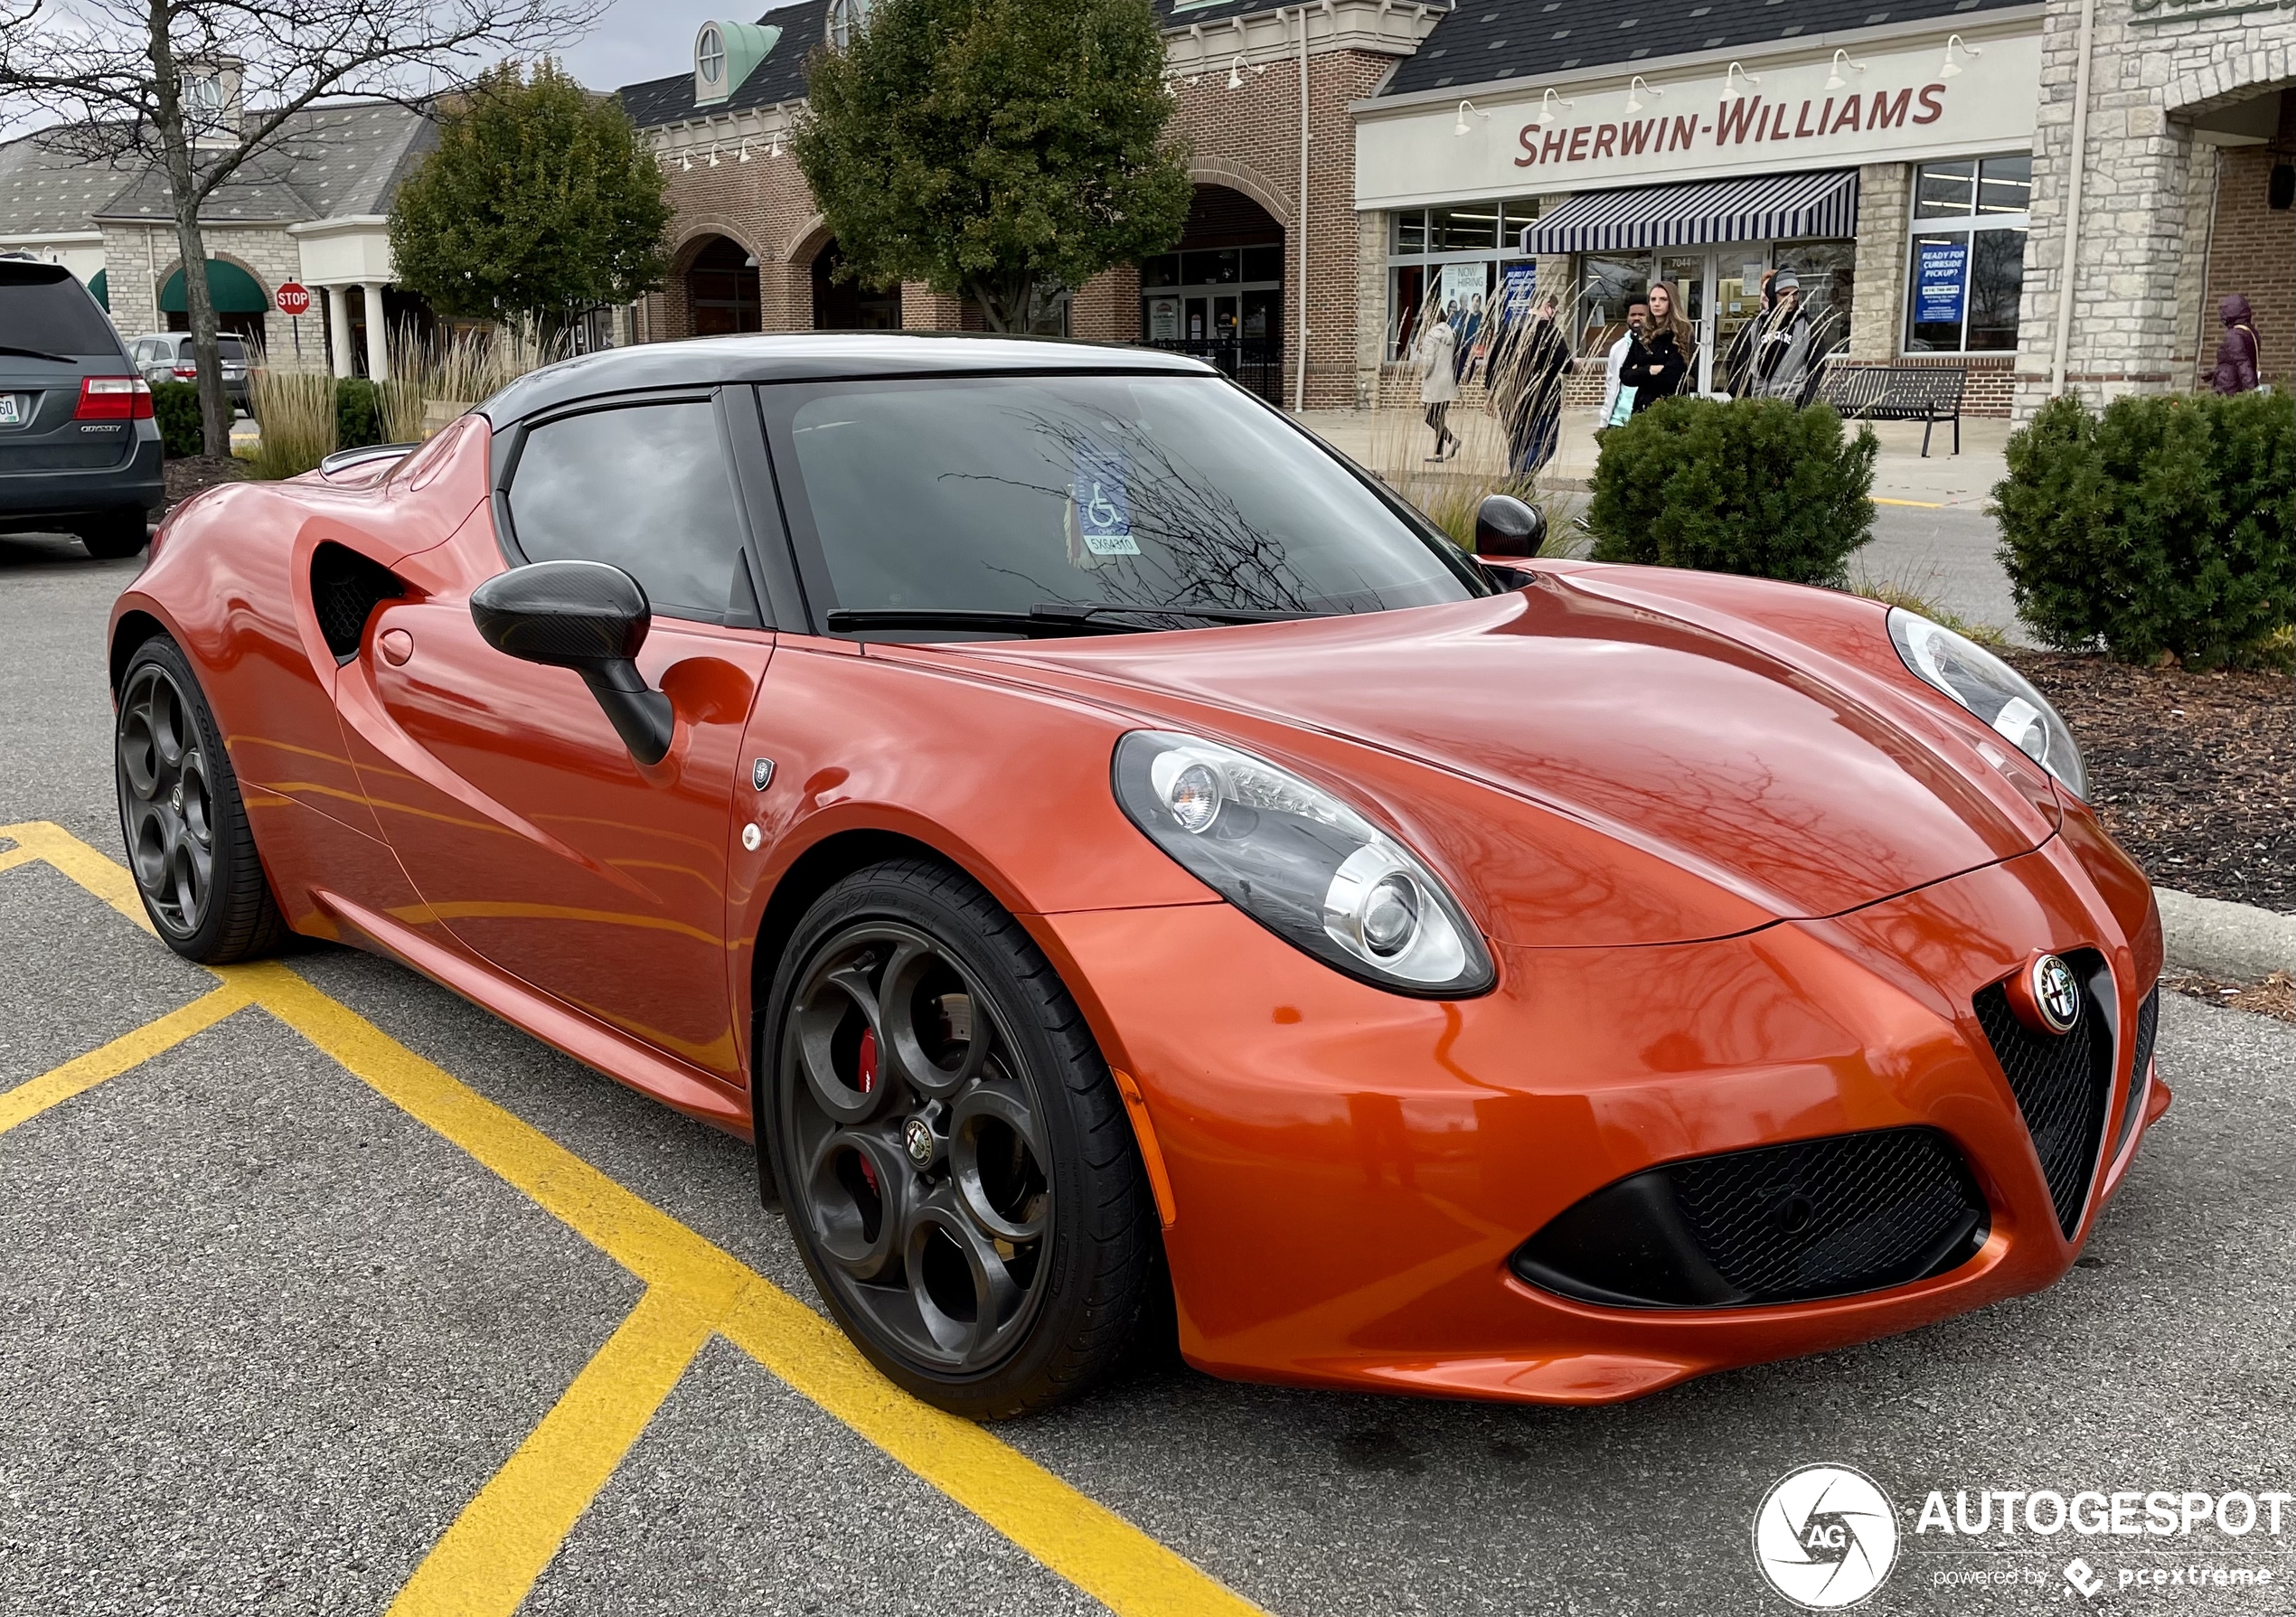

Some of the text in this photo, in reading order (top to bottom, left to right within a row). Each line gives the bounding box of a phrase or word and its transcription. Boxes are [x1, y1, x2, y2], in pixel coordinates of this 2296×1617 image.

[1513, 83, 1947, 169] SHERWIN-WILLIAMS
[1922, 250, 1965, 259] READY FOR
[1671, 258, 1691, 268] 7044
[1923, 259, 1962, 268] CURBSIDE
[1457, 267, 1478, 277] NOW
[1924, 268, 1959, 277] PICKUP?
[1457, 276, 1484, 287] HIRING
[278, 292, 308, 306] STOP
[80, 425, 122, 433] ODYSSEY
